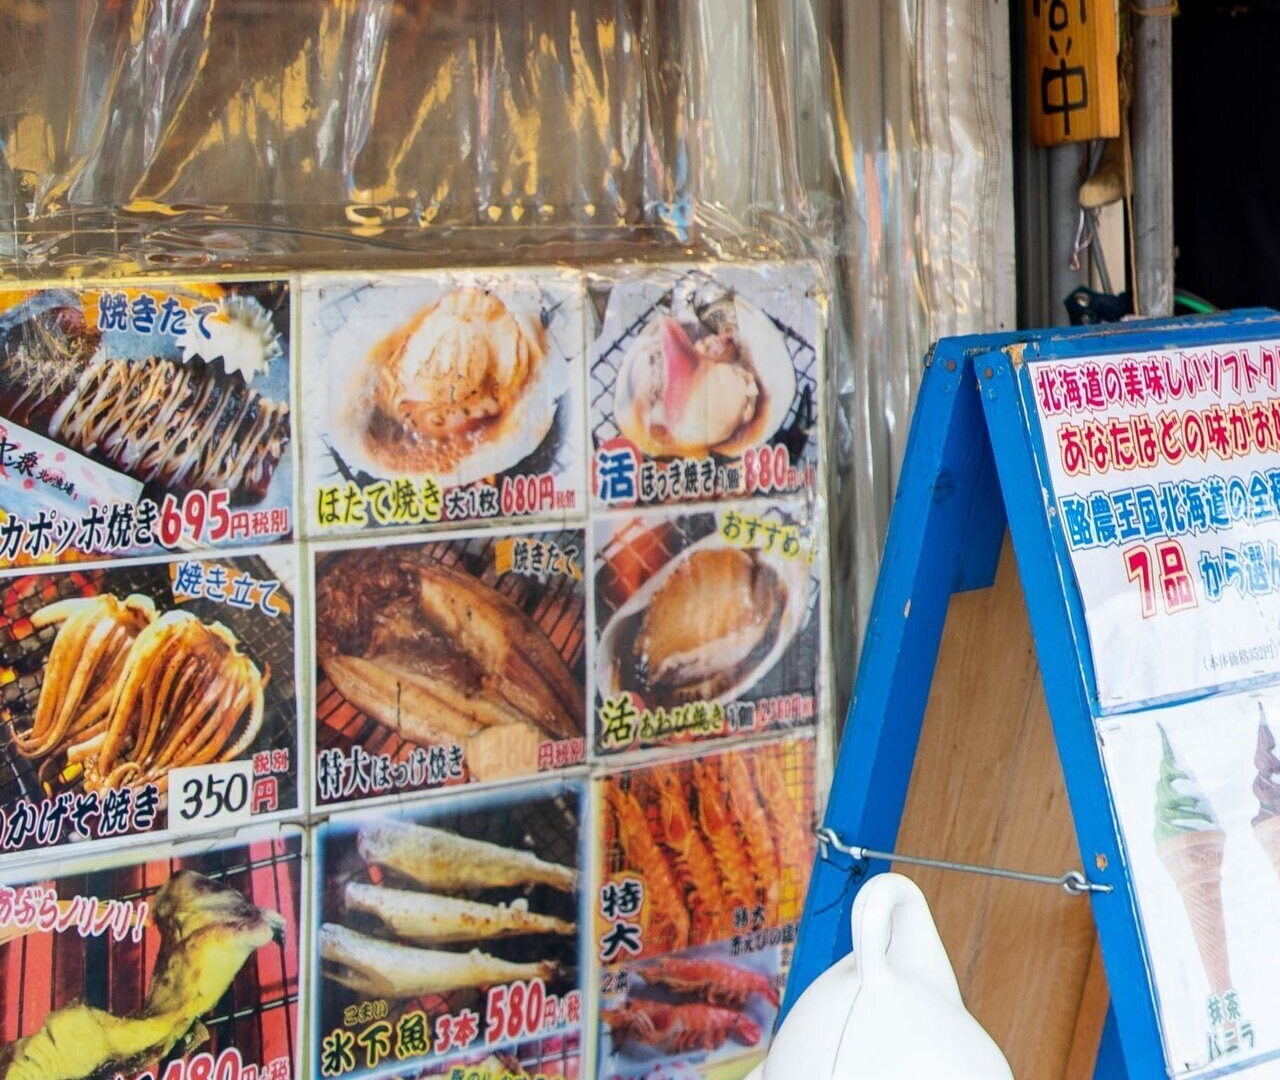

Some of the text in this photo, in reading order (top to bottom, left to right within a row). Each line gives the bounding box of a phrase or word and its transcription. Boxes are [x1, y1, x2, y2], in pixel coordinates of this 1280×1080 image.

[98, 292, 222, 339] 焼きたて
[599, 451, 635, 502] 活
[316, 477, 443, 527] ほたて焼き
[512, 539, 580, 578] 焼きたて
[174, 562, 282, 616] 焼き立て
[179, 773, 248, 820] 350
[251, 777, 279, 815] 円
[318, 744, 464, 799] 特大ほっけ焼き
[601, 881, 643, 958] 特大
[1207, 990, 1243, 1026] 抹茶
[321, 1009, 430, 1076] 氷下魚
[435, 1009, 479, 1055] 3本
[1207, 1023, 1258, 1059] バニラ
